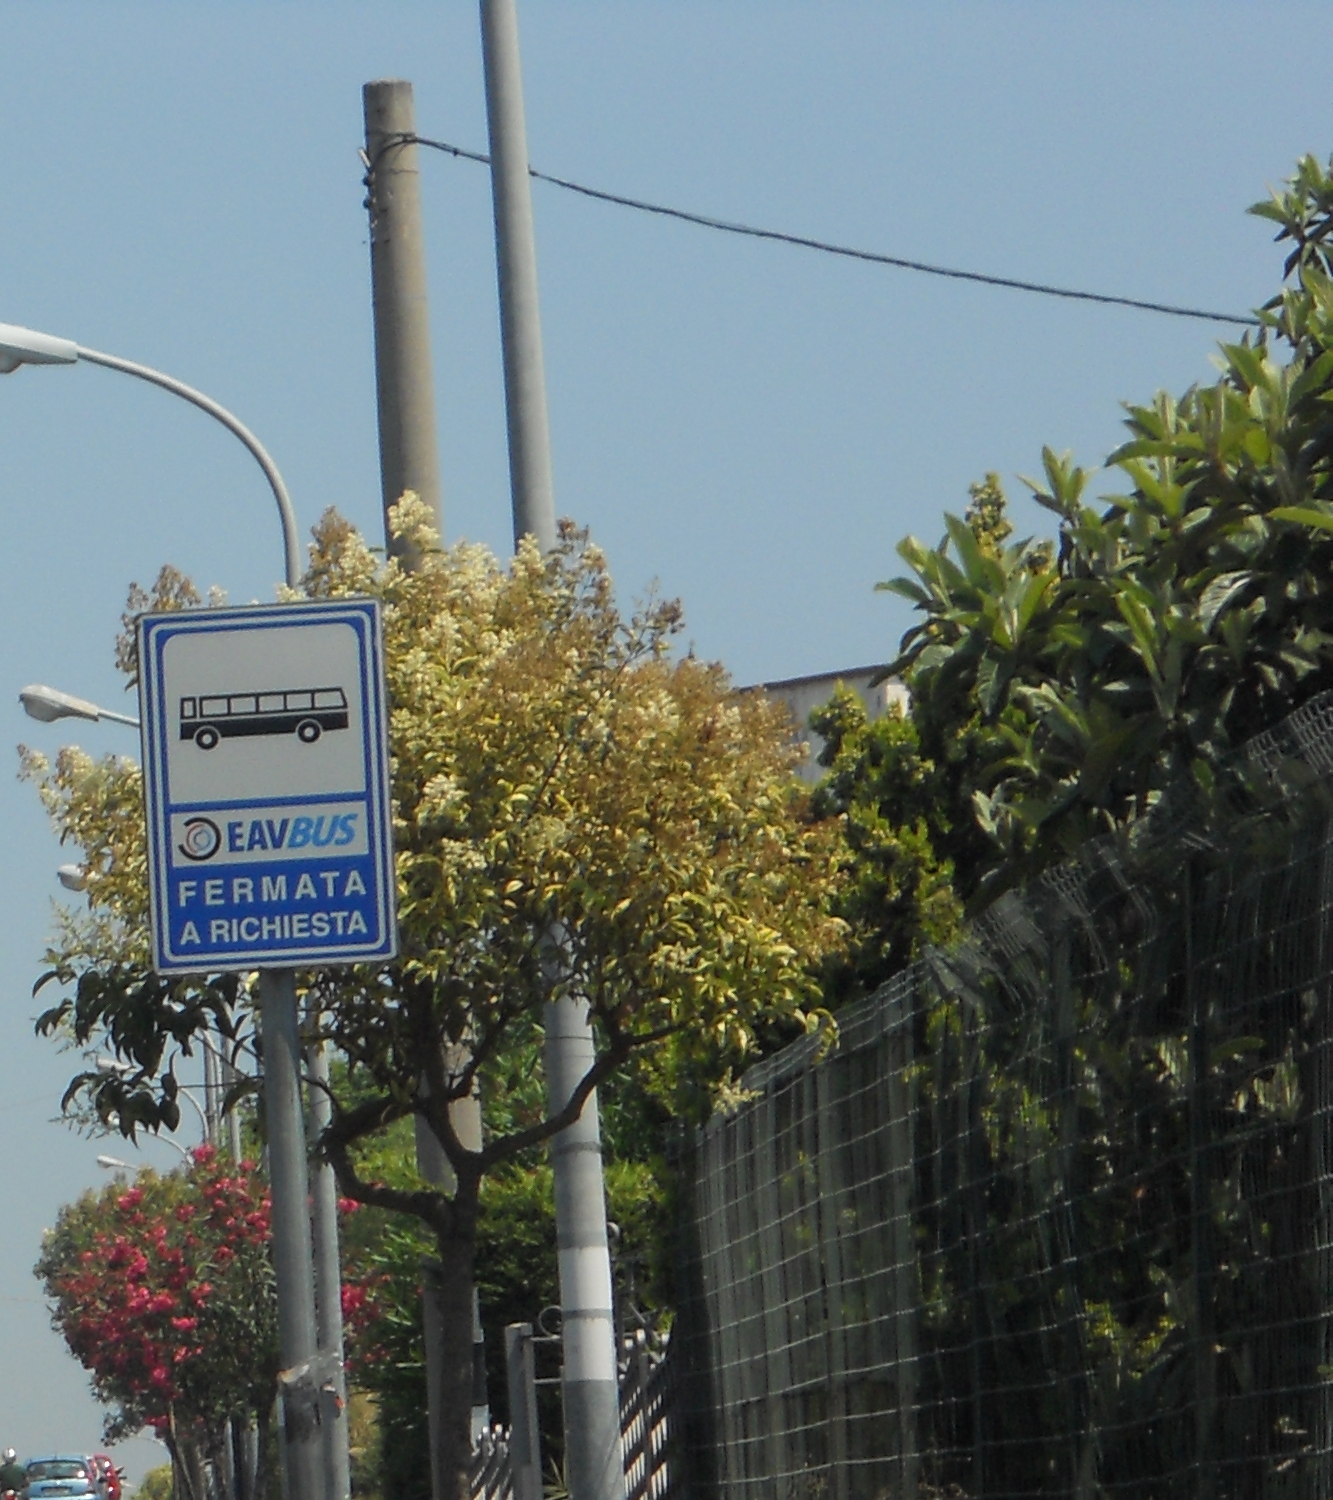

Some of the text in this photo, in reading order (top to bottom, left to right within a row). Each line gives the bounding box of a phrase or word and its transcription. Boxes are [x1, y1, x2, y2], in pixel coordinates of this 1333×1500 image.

[227, 812, 359, 853] EAVBUS
[178, 869, 367, 907] FERMATA
[180, 910, 368, 945] A RICHIESTA
